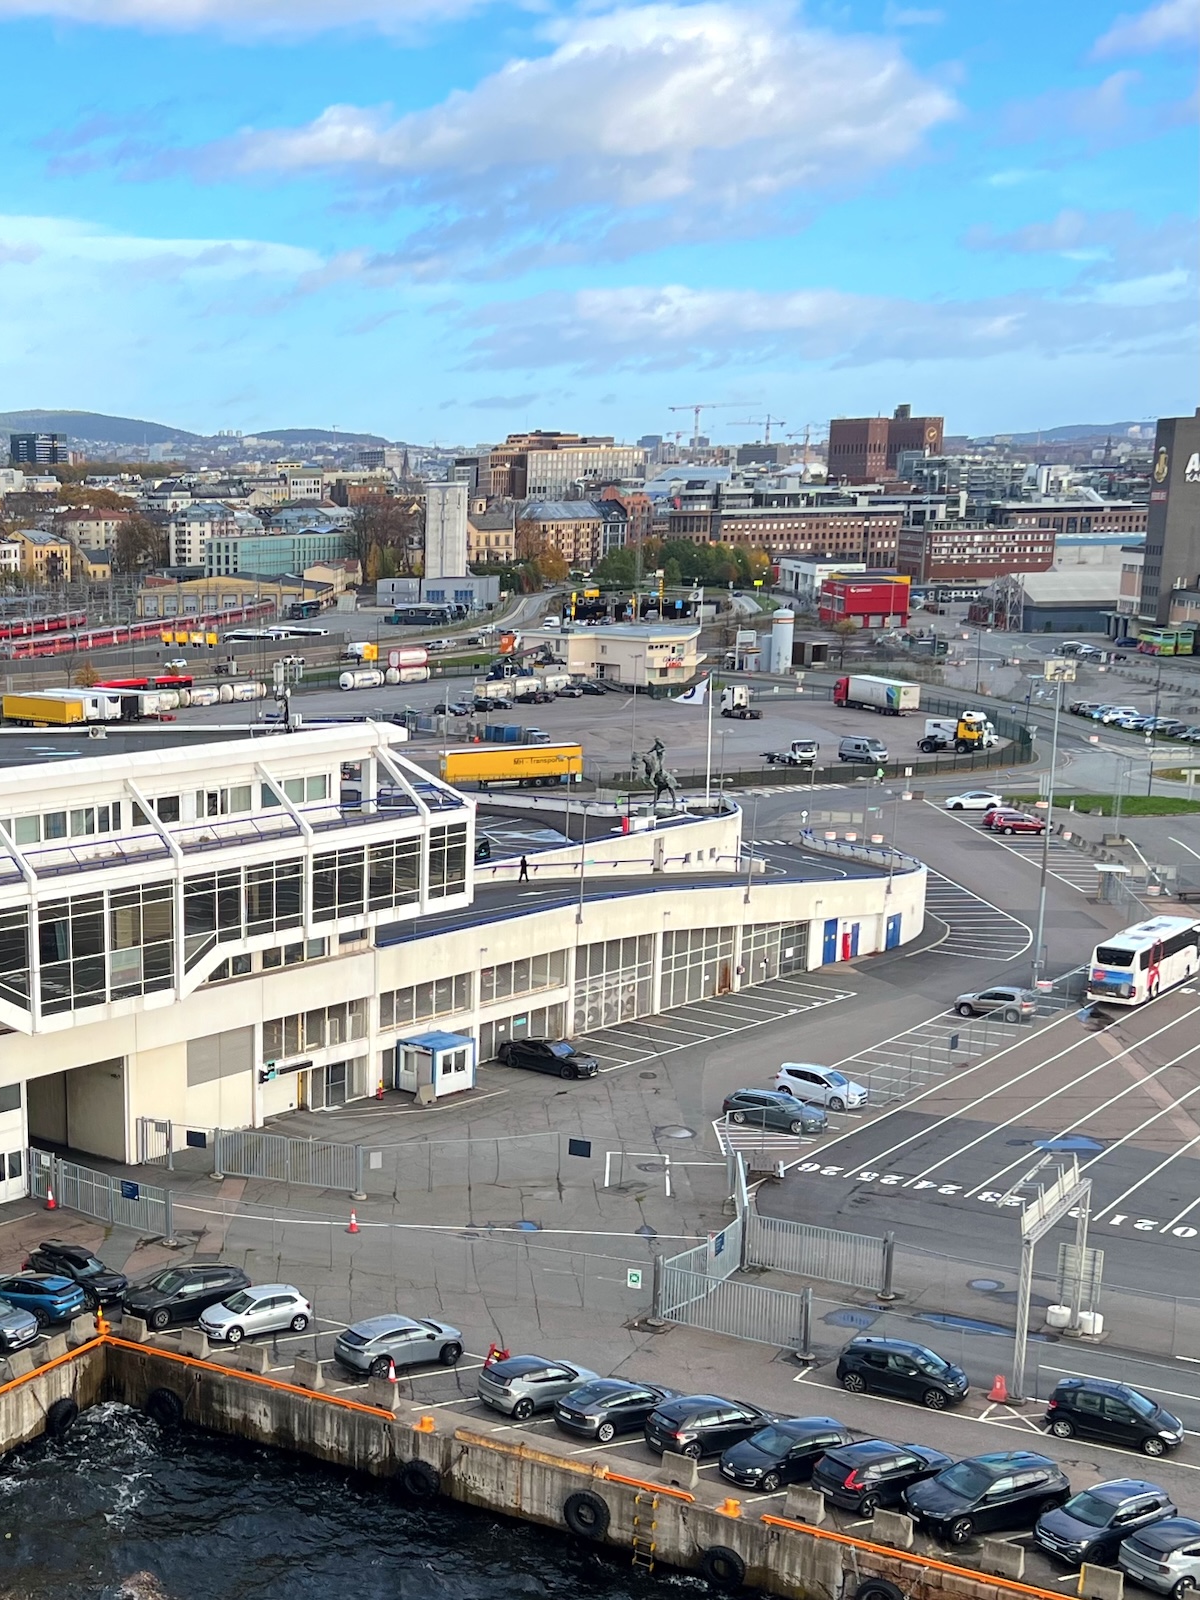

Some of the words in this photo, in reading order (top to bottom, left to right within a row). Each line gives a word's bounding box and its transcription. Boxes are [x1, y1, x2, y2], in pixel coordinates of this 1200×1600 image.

[797, 1162, 845, 1176] 26
[856, 1171, 905, 1185] 25
[913, 1179, 963, 1195] 24
[977, 1191, 1027, 1206] 23
[1108, 1214, 1159, 1231] 21
